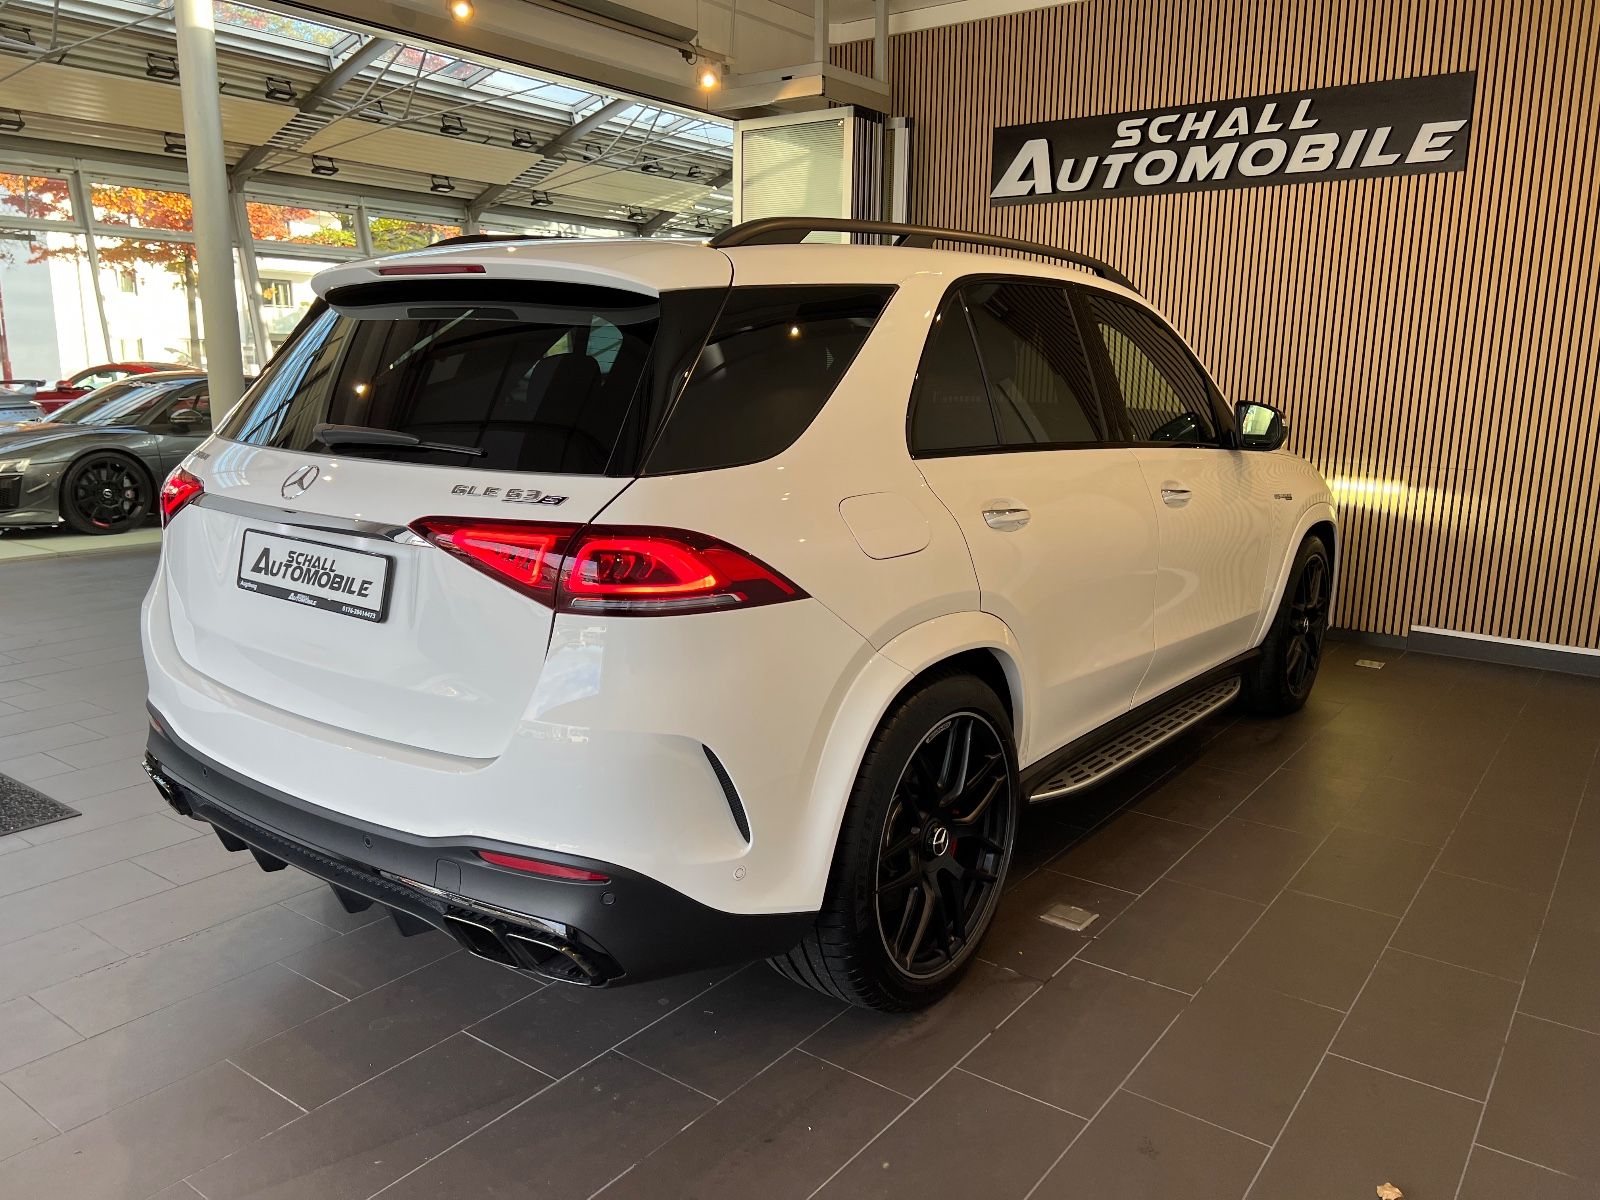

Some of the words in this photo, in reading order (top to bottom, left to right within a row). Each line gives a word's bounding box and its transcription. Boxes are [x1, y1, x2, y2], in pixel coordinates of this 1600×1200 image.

[1112, 98, 1319, 148] SCHALL
[990, 119, 1467, 198] AUTOMOBILE
[451, 484, 501, 497] GLE
[505, 488, 542, 500] 63
[250, 547, 374, 598] AUTOMOBILE
[286, 550, 337, 573] SCHALL
